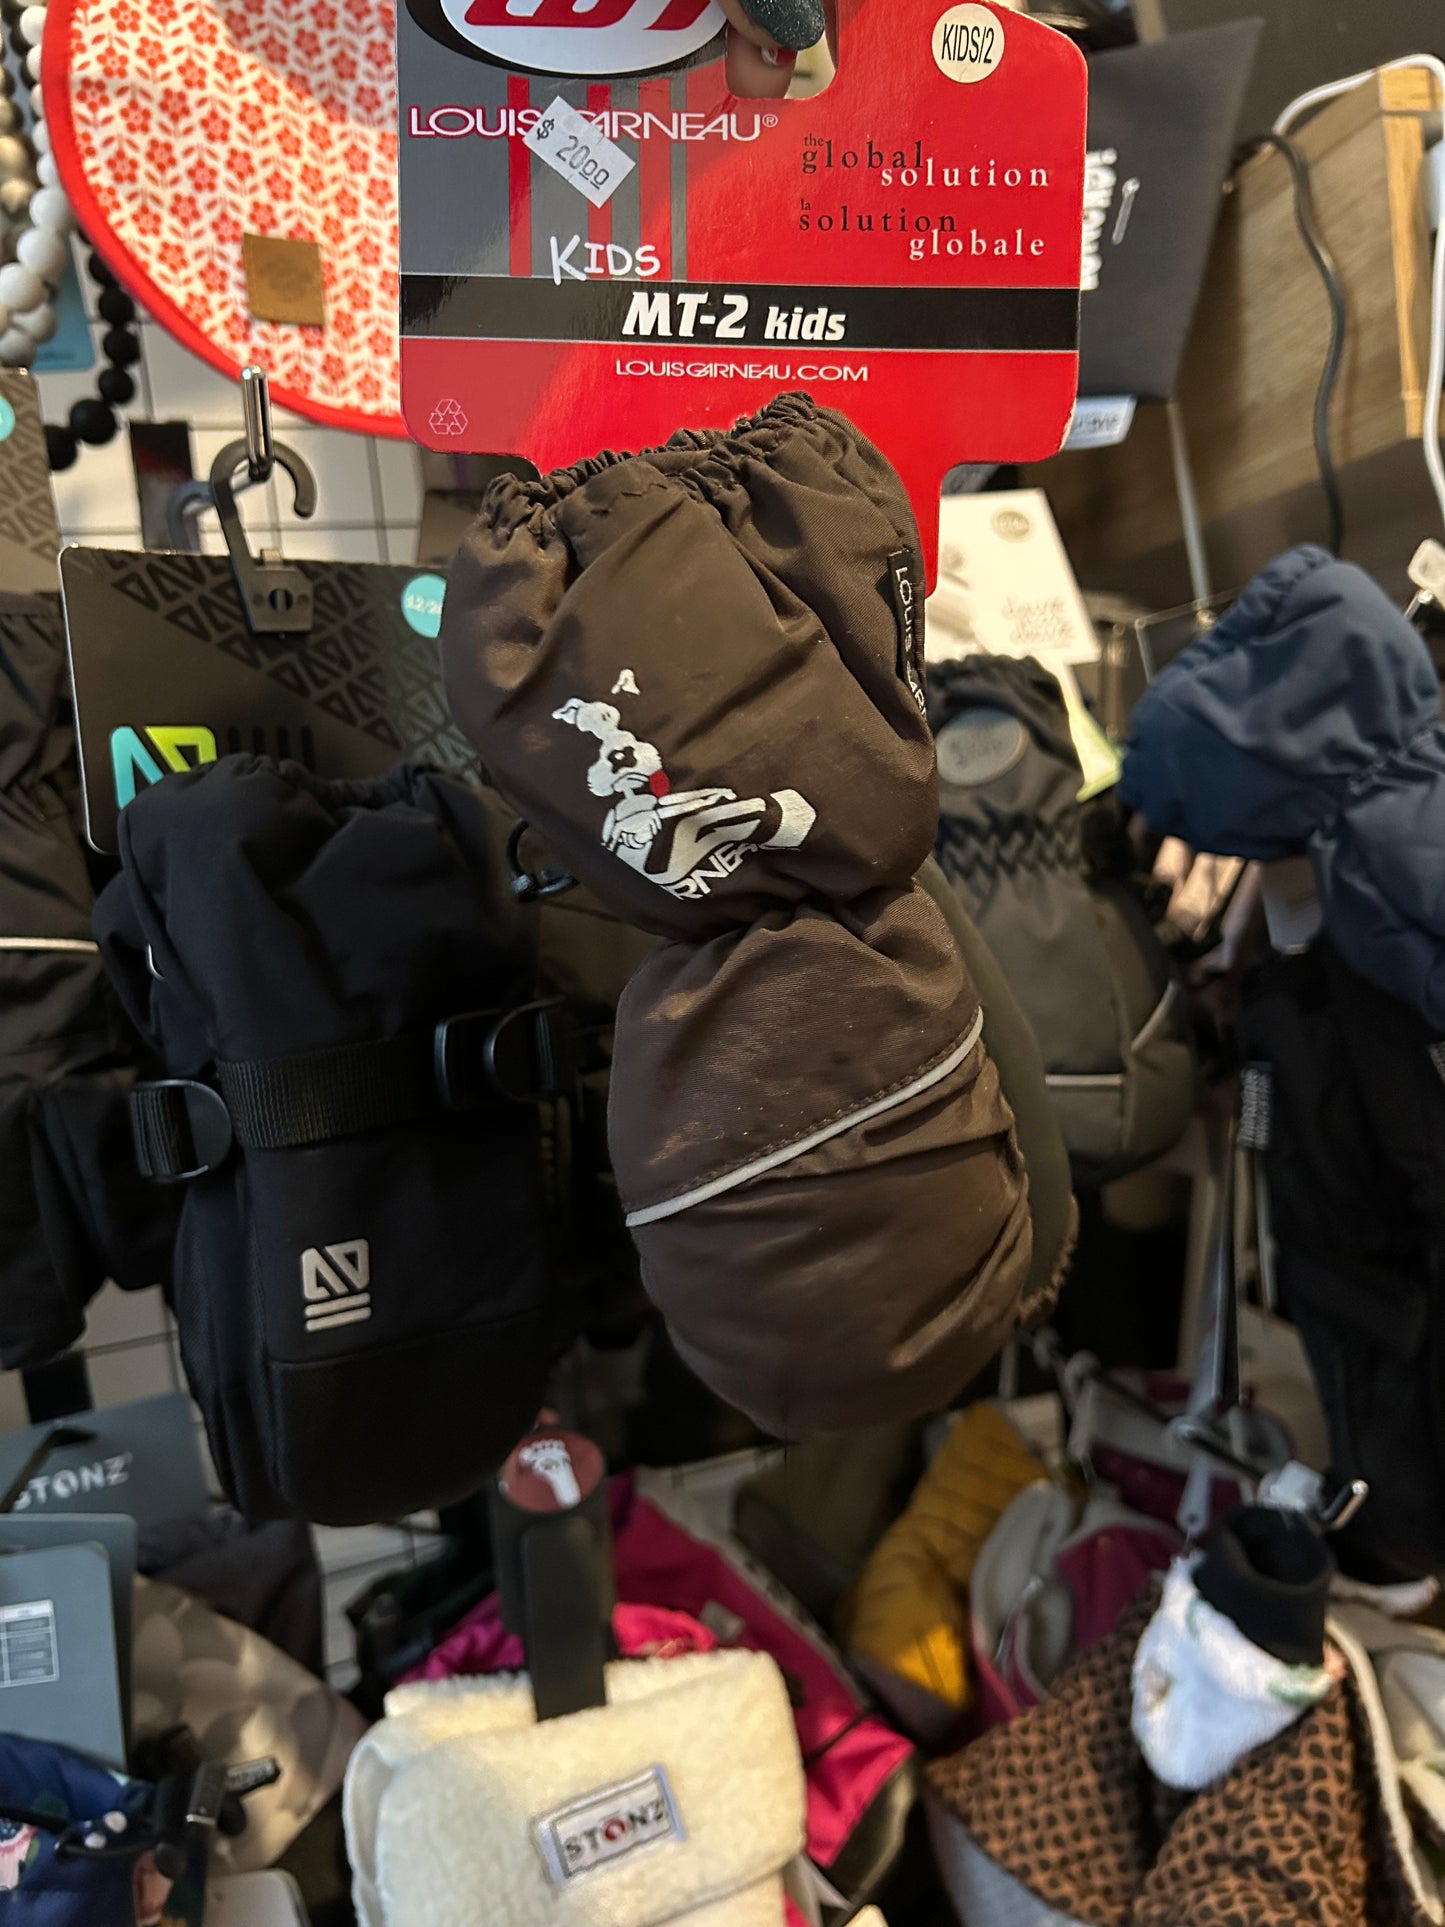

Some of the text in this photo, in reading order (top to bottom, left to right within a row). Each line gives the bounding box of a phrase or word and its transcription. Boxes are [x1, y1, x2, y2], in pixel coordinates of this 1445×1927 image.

[941, 23, 994, 64] KIDS/2
[411, 107, 779, 142] LOUIS ARNEAU®
[804, 133, 825, 147] the
[802, 139, 923, 174] global
[881, 157, 1049, 187] solution
[799, 205, 957, 232] solution
[800, 198, 812, 211] la
[550, 234, 661, 286] KIDS
[909, 228, 1045, 261] globale
[621, 291, 846, 341] MT-2 kids
[615, 359, 869, 382] LOUISGARNEAU.COM
[895, 566, 913, 653] LOUIS
